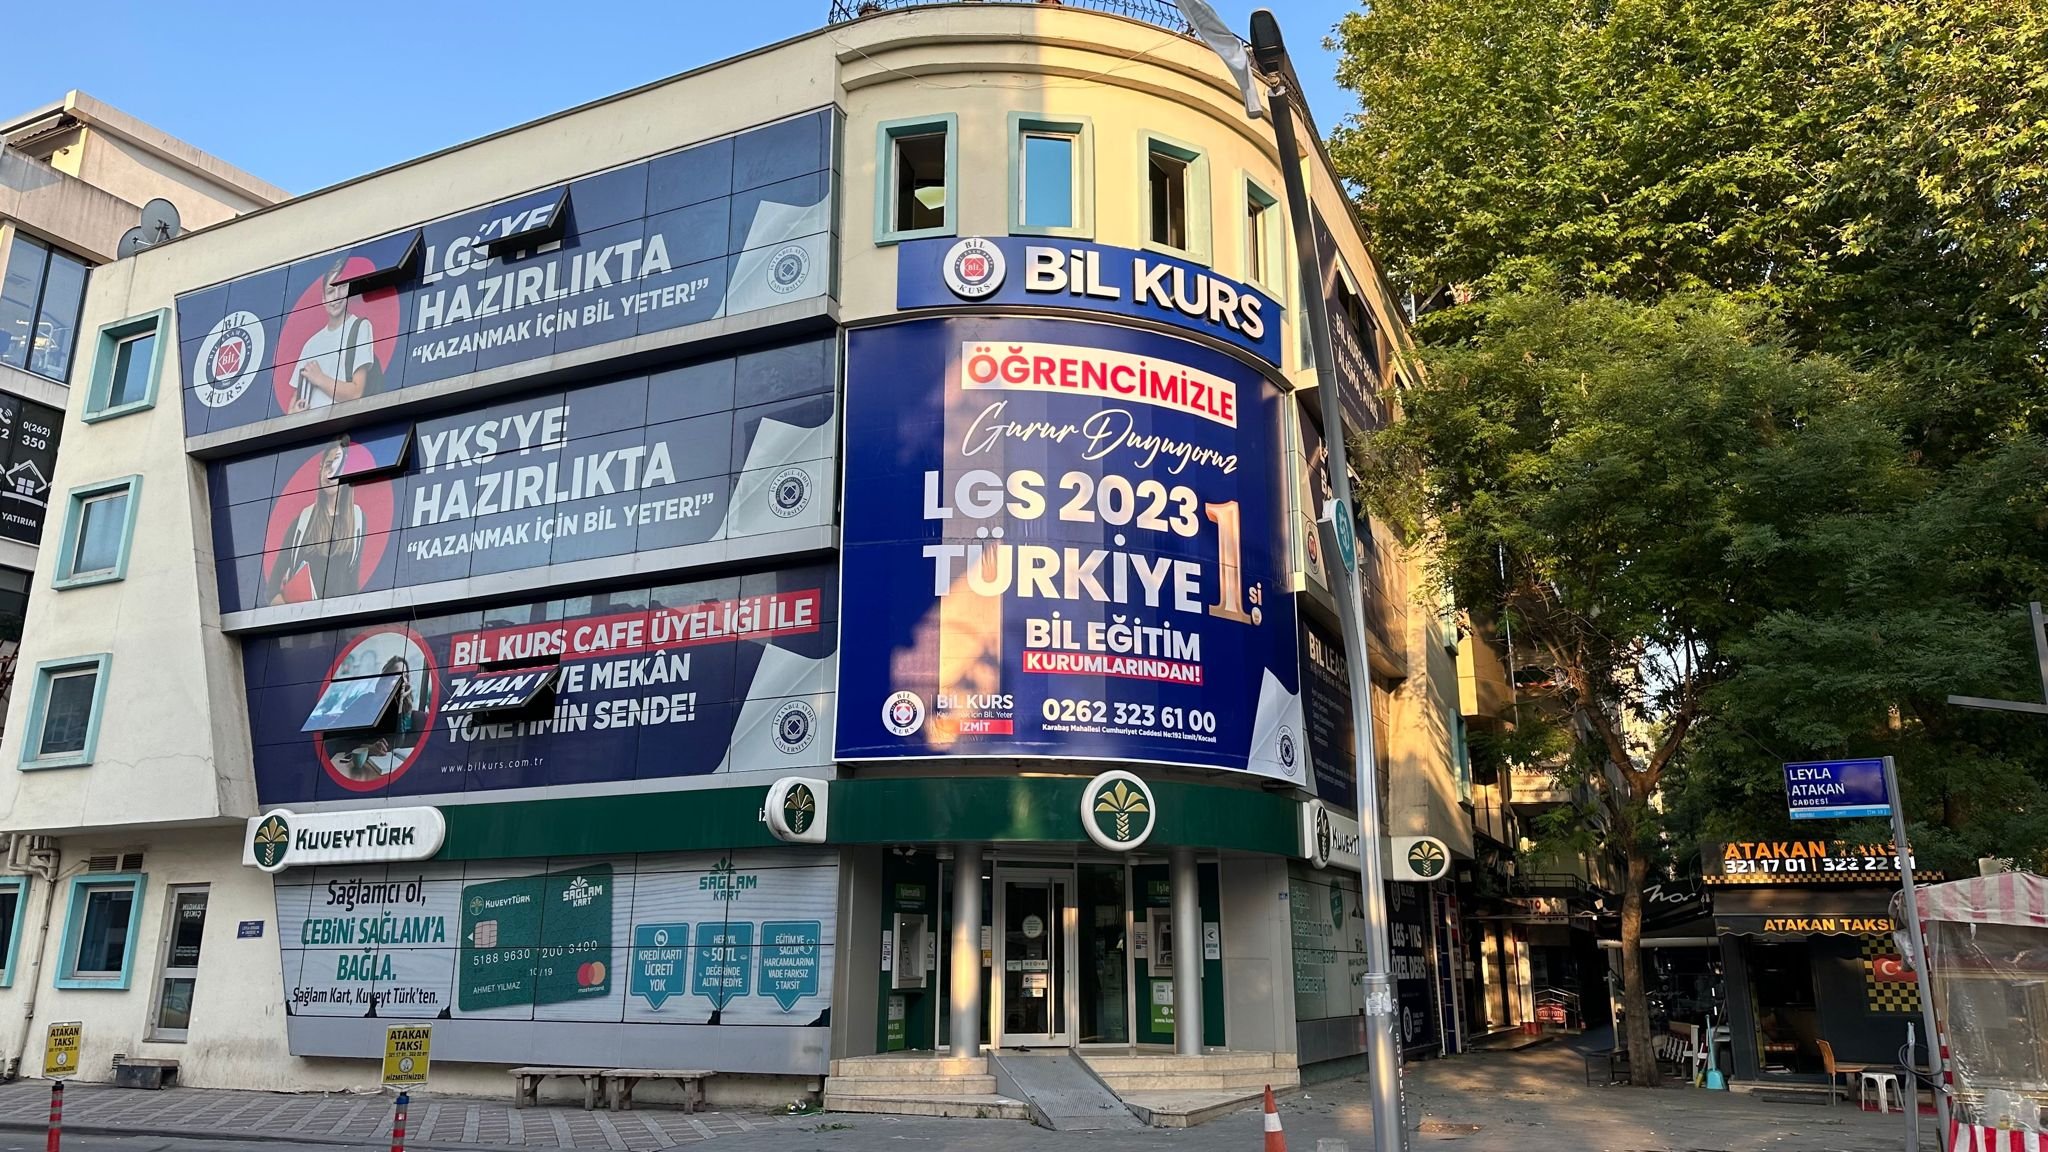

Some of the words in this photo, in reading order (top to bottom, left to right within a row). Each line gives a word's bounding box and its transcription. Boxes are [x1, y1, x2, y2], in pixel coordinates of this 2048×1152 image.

[417, 233, 672, 334] HAZIRLIKTA
[1134, 257, 1265, 339] KURS
[535, 308, 577, 338] İÇİN
[583, 298, 614, 326] BİL
[967, 345, 1234, 422] ÖĞRENCİMİZLE
[23, 421, 50, 438] 0(262)
[961, 399, 1078, 457] Gurur
[1081, 408, 1239, 475] Duyuyoruz
[22, 435, 46, 450] 350
[421, 405, 570, 475] YKS'YE
[412, 442, 676, 527] HAZIRLIKTA
[923, 469, 1046, 520] LGS
[1059, 470, 1200, 537] 2023
[2, 511, 37, 528] YATIRIM
[535, 513, 577, 544] İÇİN
[583, 505, 617, 531] BİL
[923, 526, 1202, 614] TÜRKİYE
[455, 633, 491, 666] BİL
[498, 628, 567, 661] KURS
[573, 619, 644, 652] CAFE
[651, 596, 760, 643] ÜYELİĞİ
[769, 595, 813, 629] İLE
[1026, 610, 1081, 650] BİL
[1087, 613, 1200, 661] EĞİTİM
[590, 650, 691, 689] MEKÂN
[1027, 653, 1201, 682] KURUMLARINDAN!
[937, 694, 963, 709] BİL
[966, 694, 1013, 709] KURS
[592, 692, 697, 731] SENDE!
[1042, 698, 1107, 723] 0262
[1113, 702, 1155, 726] 323
[1161, 707, 1183, 729] 61
[1188, 710, 1216, 733] 00
[1042, 724, 1069, 732] Karabaş
[1070, 725, 1100, 733] Mahallesi
[1102, 726, 1137, 736] Cumhuriyet
[1139, 729, 1162, 738] Caddesi
[441, 758, 544, 774] www.bilkurs.com.tr
[1790, 768, 1831, 781] LEYLA
[1792, 783, 1845, 797] ATAKAN
[1793, 798, 1828, 806] CADDESİ
[1725, 841, 1826, 859] ATAKAN
[1725, 860, 1755, 873] 321
[1761, 859, 1779, 873] 17
[1785, 859, 1806, 872] 01
[1865, 857, 1889, 870] 22
[327, 876, 400, 911] Sağlamcı
[405, 875, 426, 907] ol,
[713, 890, 741, 901] KART
[573, 897, 592, 908] KART
[1764, 918, 1836, 931] ATAKAN
[797, 935, 805, 944] VE
[1391, 922, 1405, 947] LGS
[1409, 924, 1422, 948] YKS
[473, 953, 499, 966] 5188
[504, 949, 530, 962] 9630
[536, 945, 563, 959] 200
[569, 940, 598, 954] 3400
[639, 948, 660, 961] KREDİ
[661, 949, 682, 960] KARTI
[711, 948, 724, 962] 50
[726, 947, 737, 962] TL
[337, 948, 397, 981] BAĞLA.
[645, 961, 674, 976] ÜCRETİ
[1410, 955, 1427, 980] DERS
[702, 977, 719, 987] ALTIN
[768, 969, 783, 978] VADE
[784, 969, 809, 978] FARKSIZ
[473, 984, 495, 994] AHMET
[496, 981, 521, 992] YILMAZ
[649, 979, 666, 992] YOK
[293, 987, 327, 1006] Sağlam
[330, 988, 352, 1006] Kart,
[355, 988, 392, 1006] Kuveyt
[51, 1027, 79, 1037] ATAKAN
[390, 1029, 430, 1040] ATAKAN
[54, 1037, 75, 1046] TAKSİ
[395, 1041, 422, 1051] TAKSİ
